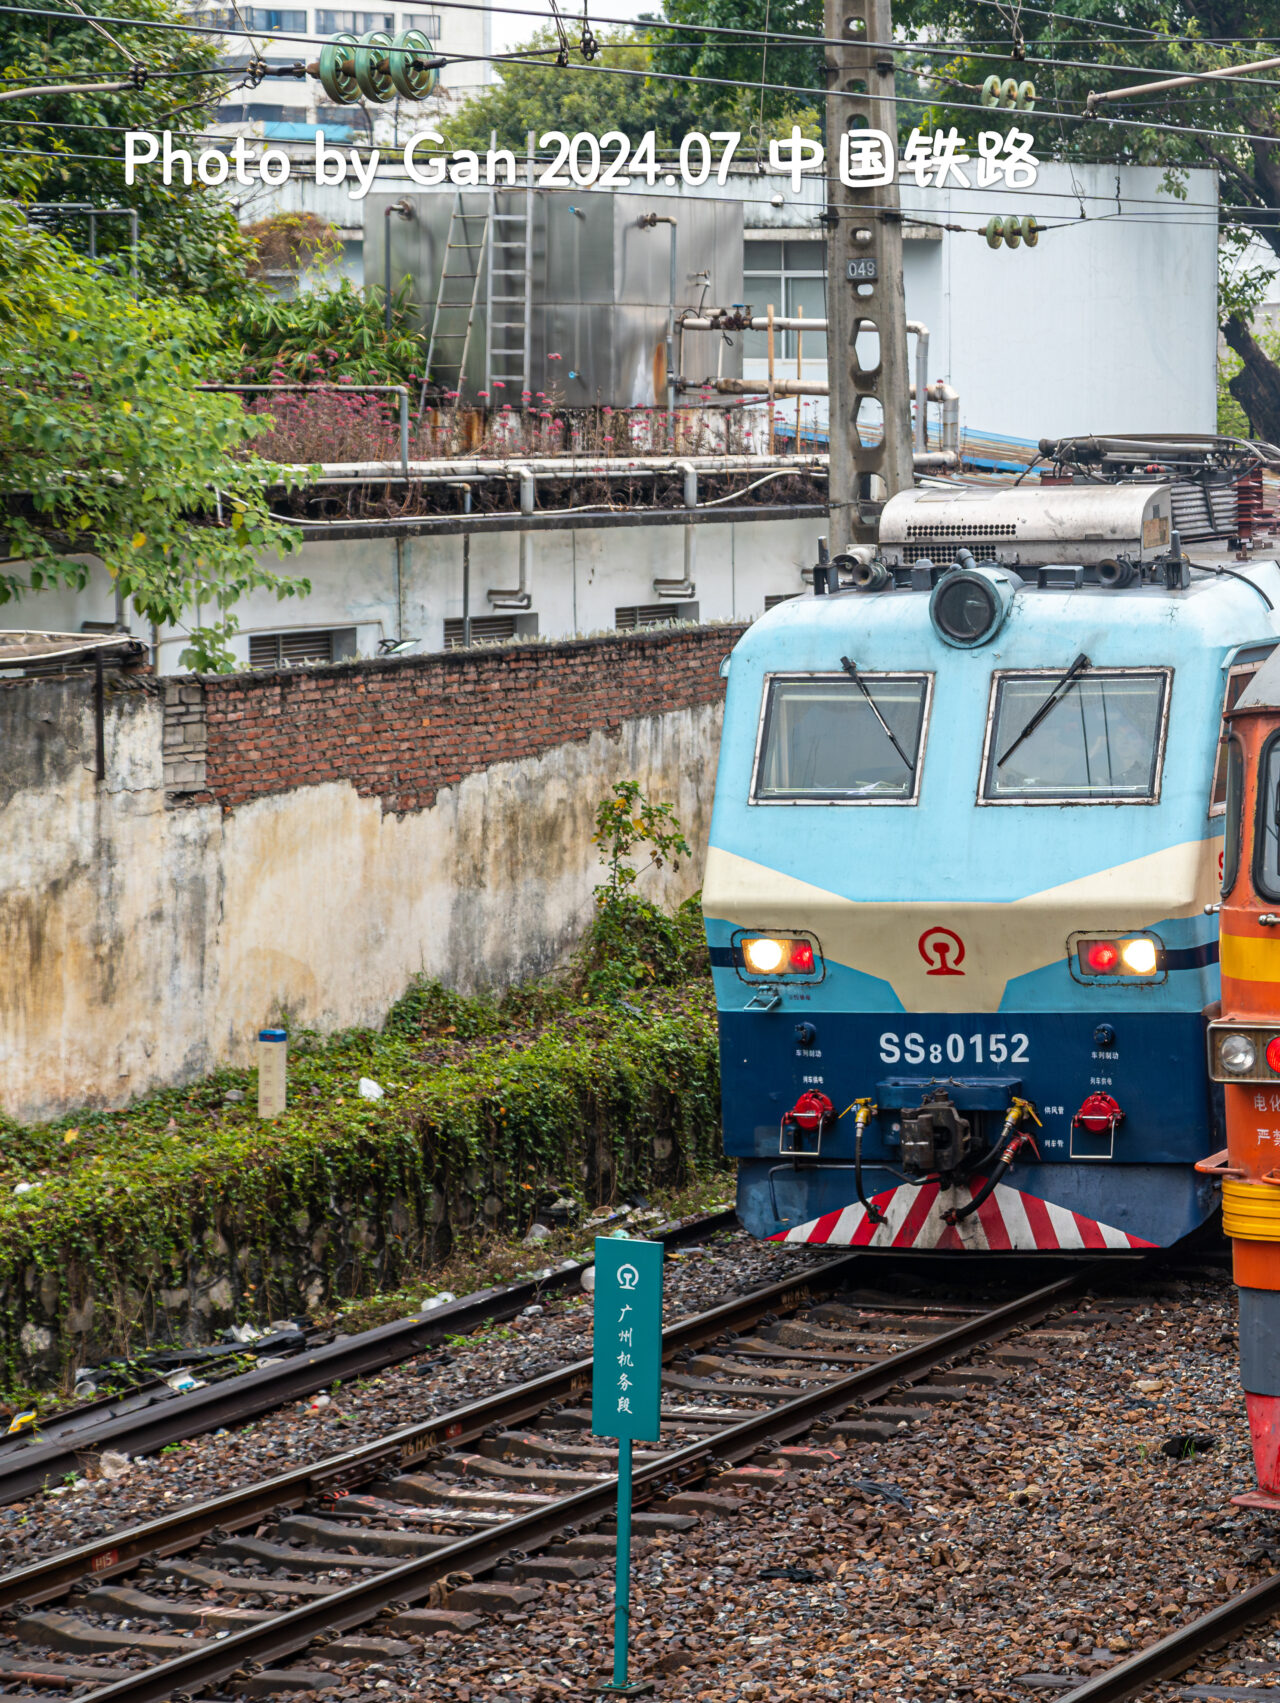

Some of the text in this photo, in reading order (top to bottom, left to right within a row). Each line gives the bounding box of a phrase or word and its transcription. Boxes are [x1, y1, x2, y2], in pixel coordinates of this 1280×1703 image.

[848, 262, 875, 277] 049
[1044, 1105, 1065, 1115] 供风管
[616, 1303, 635, 1415] 广州机务段
